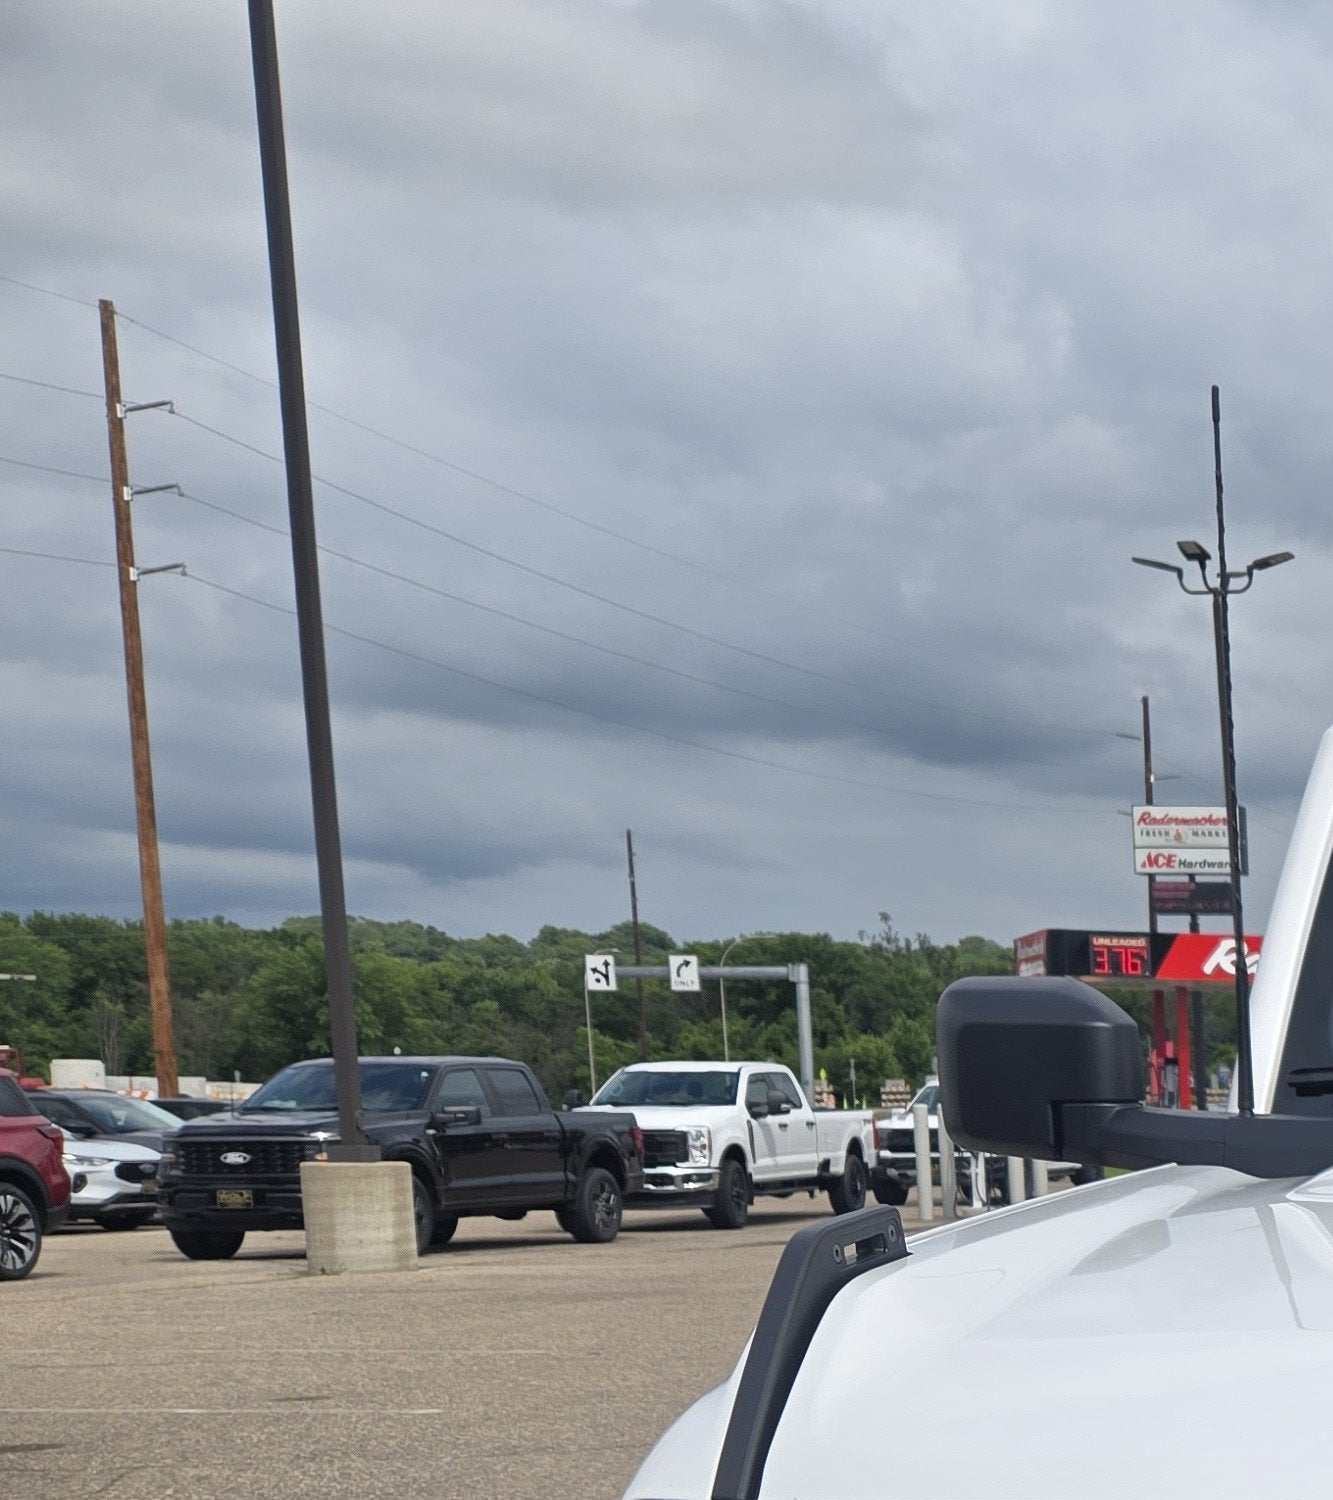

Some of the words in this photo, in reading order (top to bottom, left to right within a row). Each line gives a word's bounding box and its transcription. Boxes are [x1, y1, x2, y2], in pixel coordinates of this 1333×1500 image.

[1137, 811, 1228, 826] Radermacher
[1192, 829, 1228, 837] MARKE
[1140, 851, 1178, 869] ACE
[1093, 937, 1146, 947] UNLEADED
